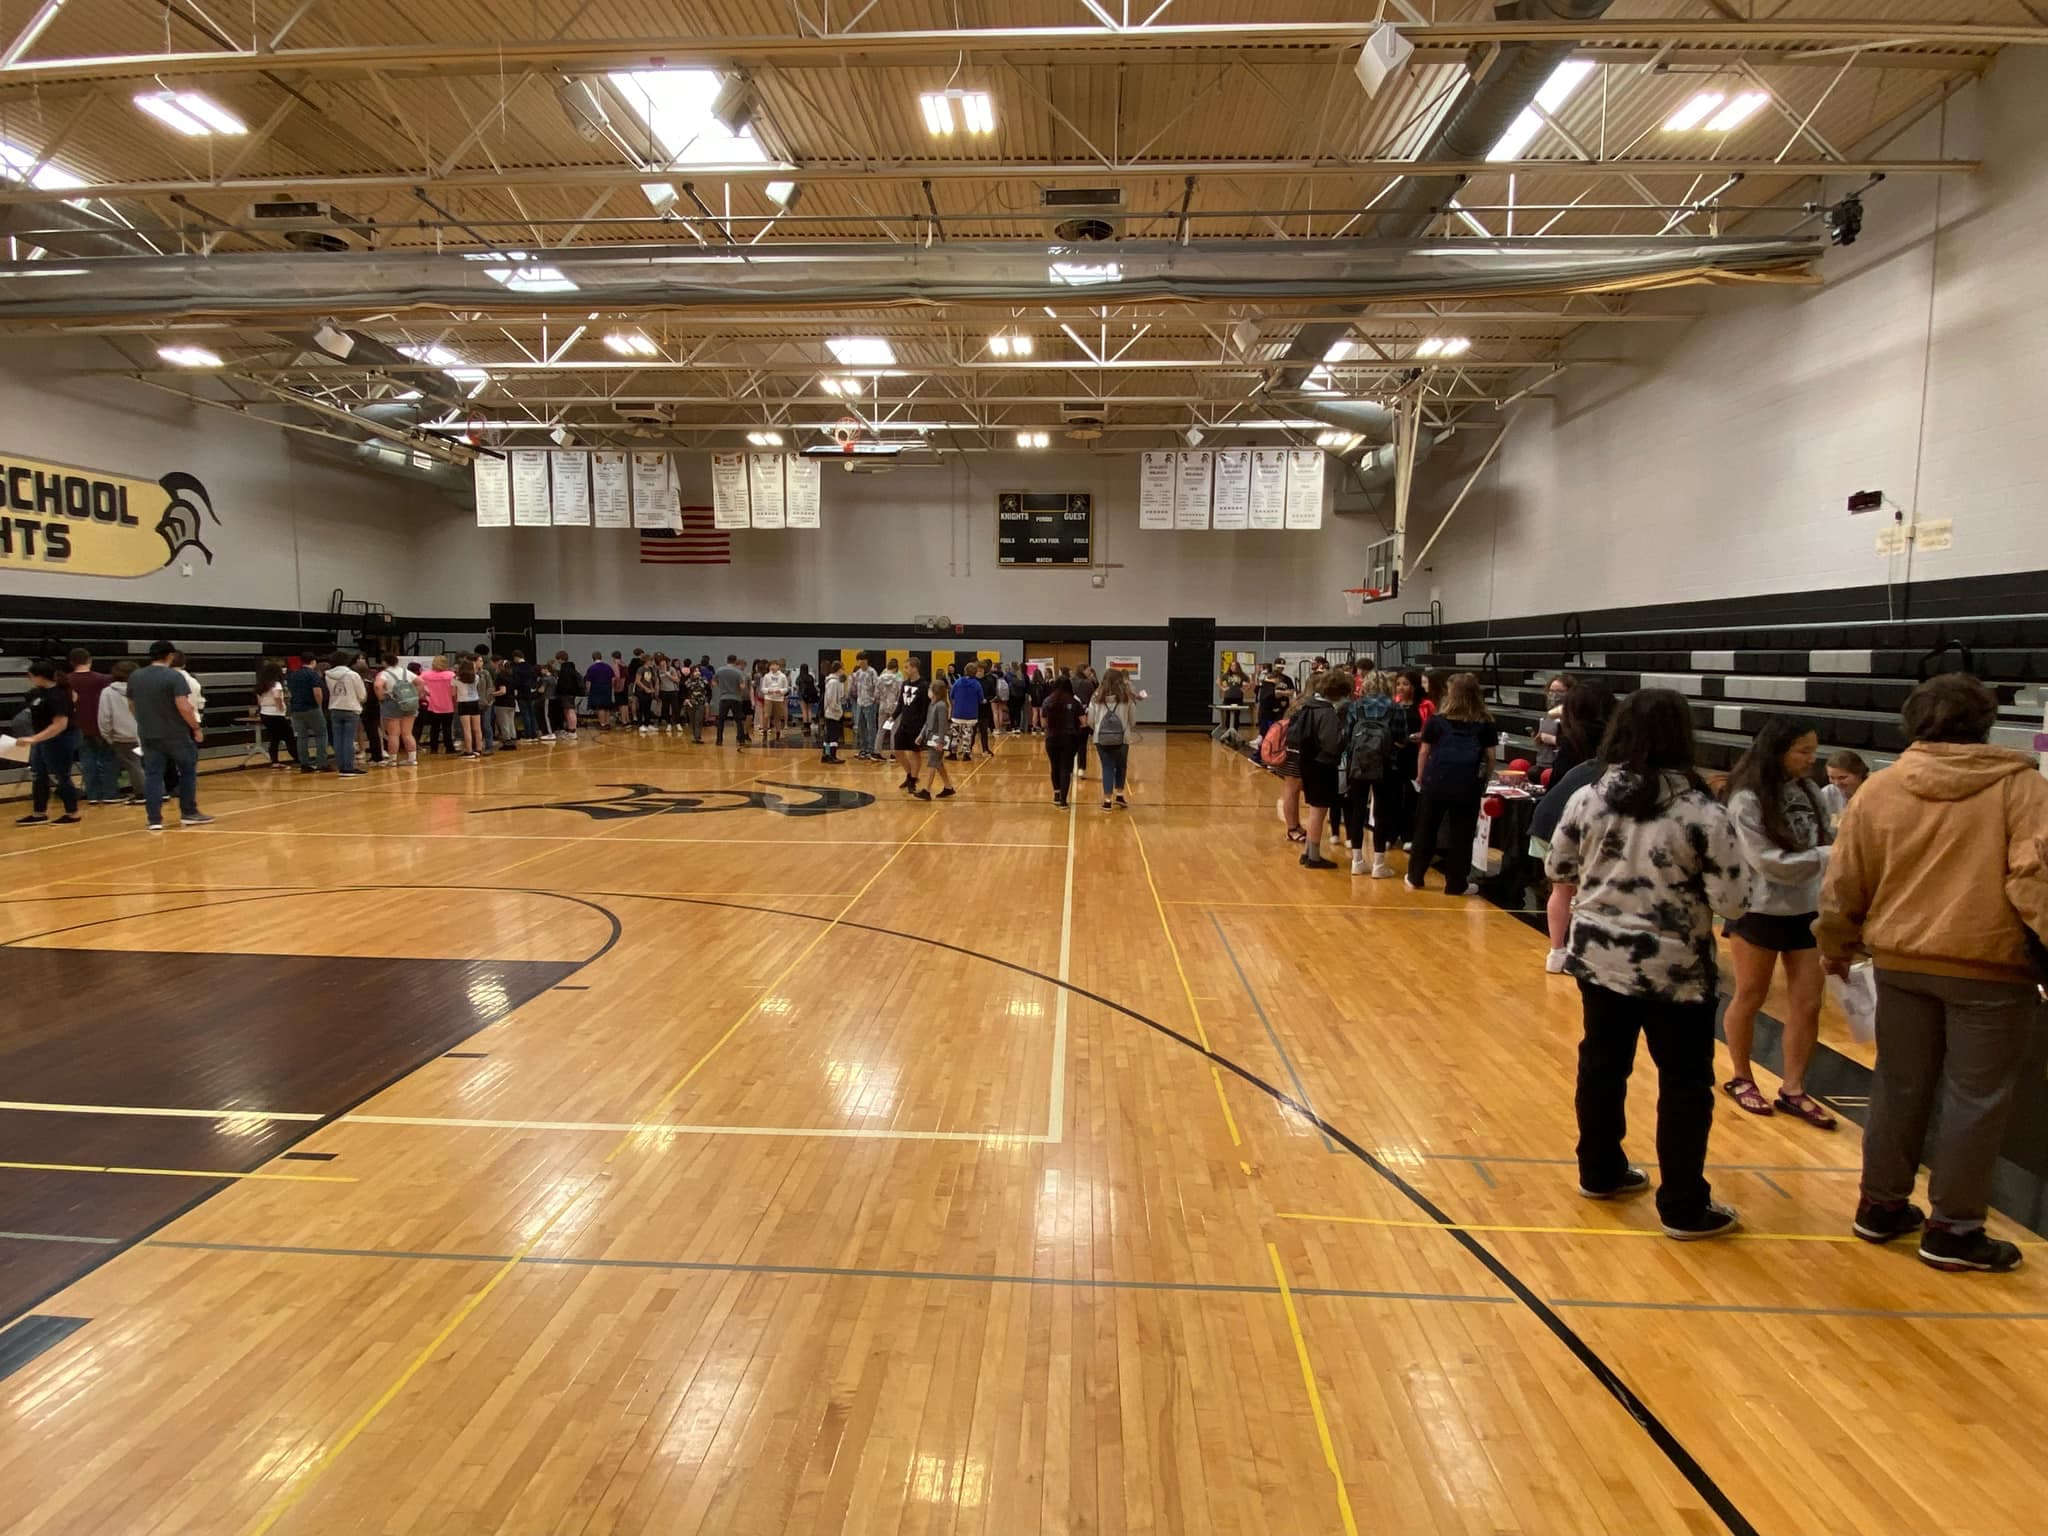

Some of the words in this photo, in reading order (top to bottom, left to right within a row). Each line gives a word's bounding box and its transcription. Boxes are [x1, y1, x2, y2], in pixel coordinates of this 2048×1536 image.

[0, 463, 139, 525] CHOOL
[1000, 512, 1029, 521] KNIGHTS
[1063, 512, 1086, 521] GUEST
